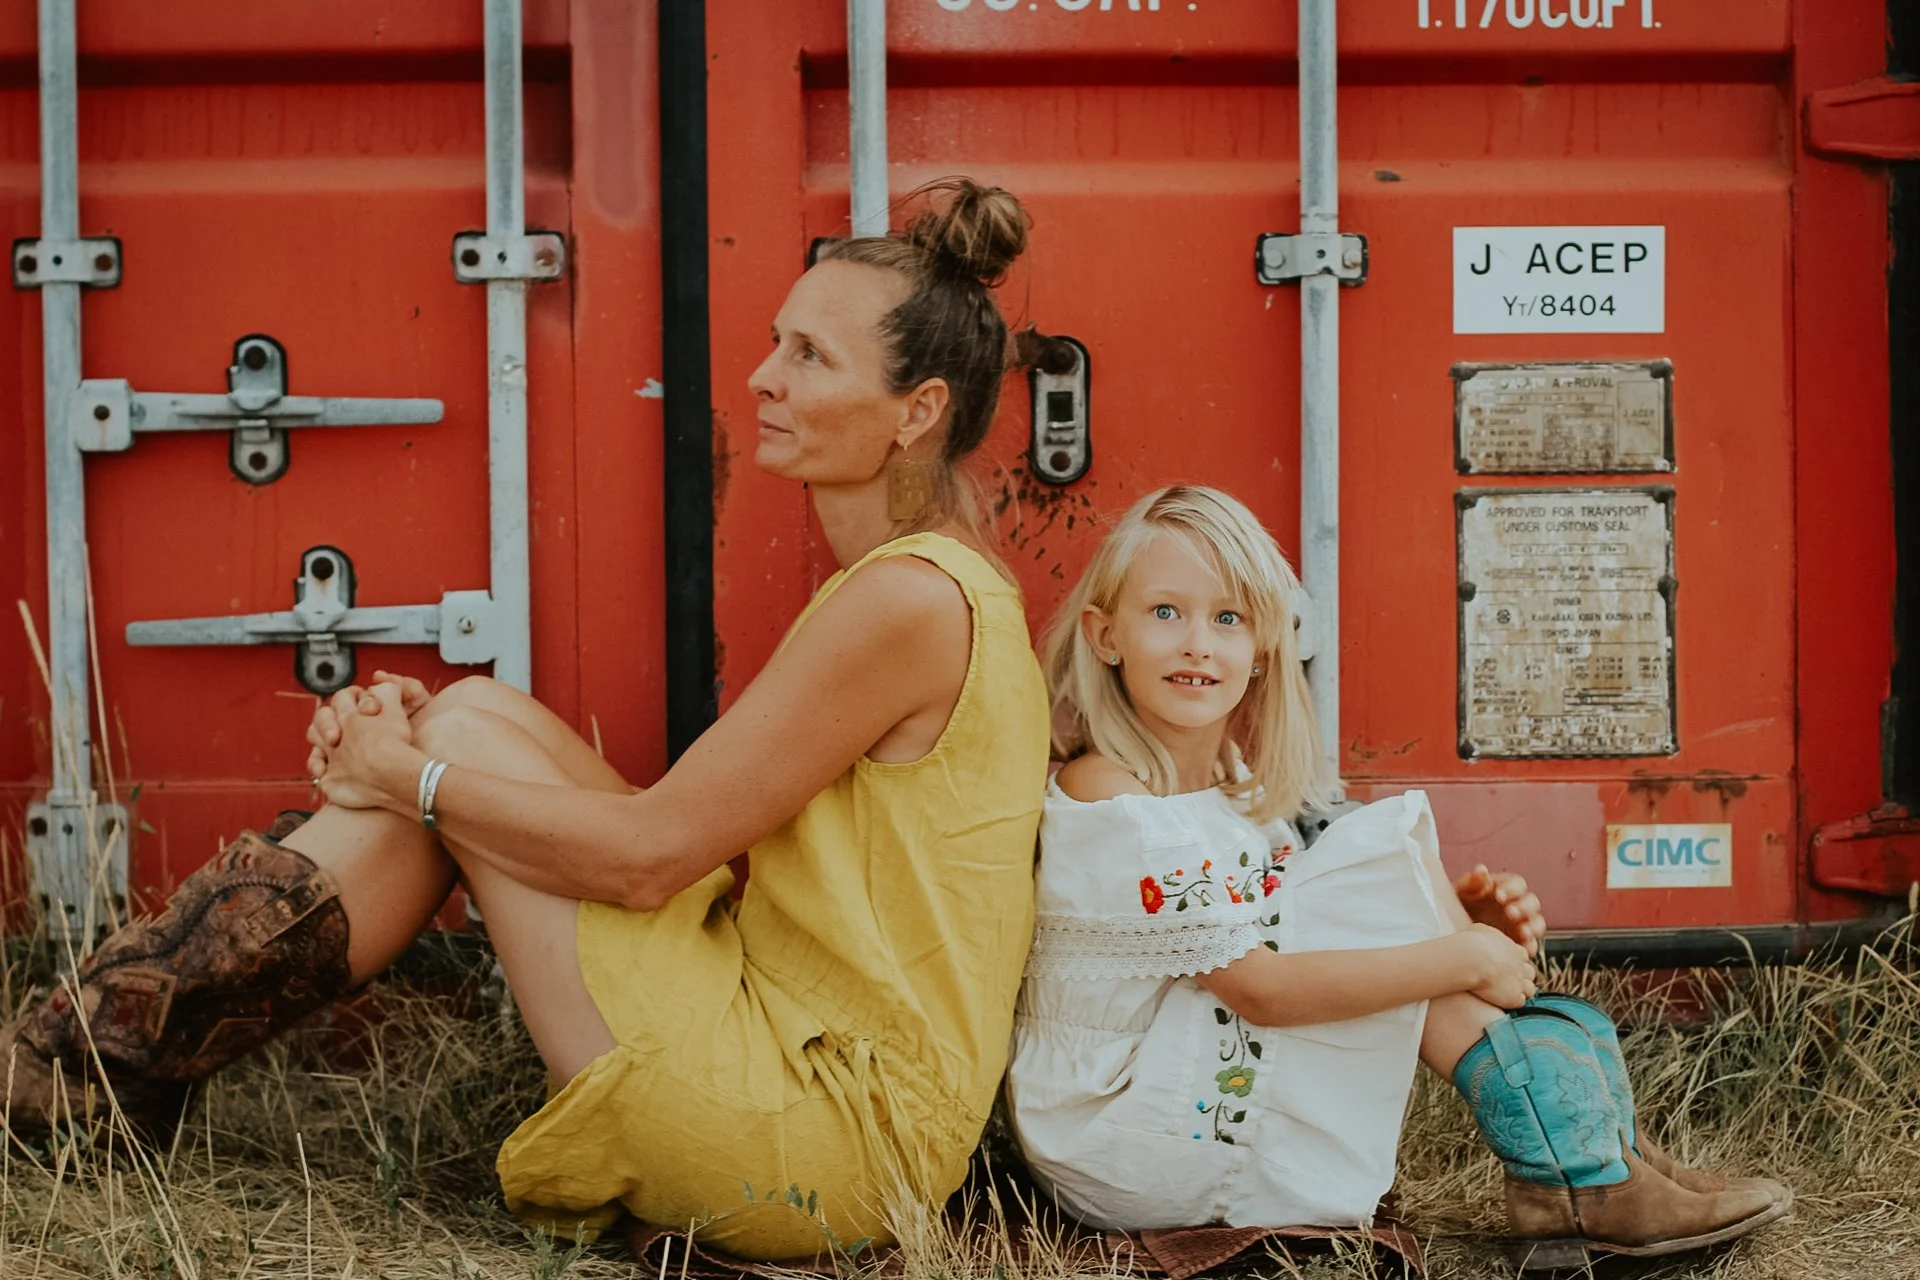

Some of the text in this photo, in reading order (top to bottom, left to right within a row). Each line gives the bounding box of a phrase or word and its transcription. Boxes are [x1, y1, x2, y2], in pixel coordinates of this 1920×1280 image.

[1470, 242, 1648, 276] J ACEP
[1485, 505, 1649, 518] APPROVED FOR TRANSPORT
[1502, 520, 1630, 533] UNDER CUSTOMS SEAL
[1616, 837, 1722, 867] CIMC
